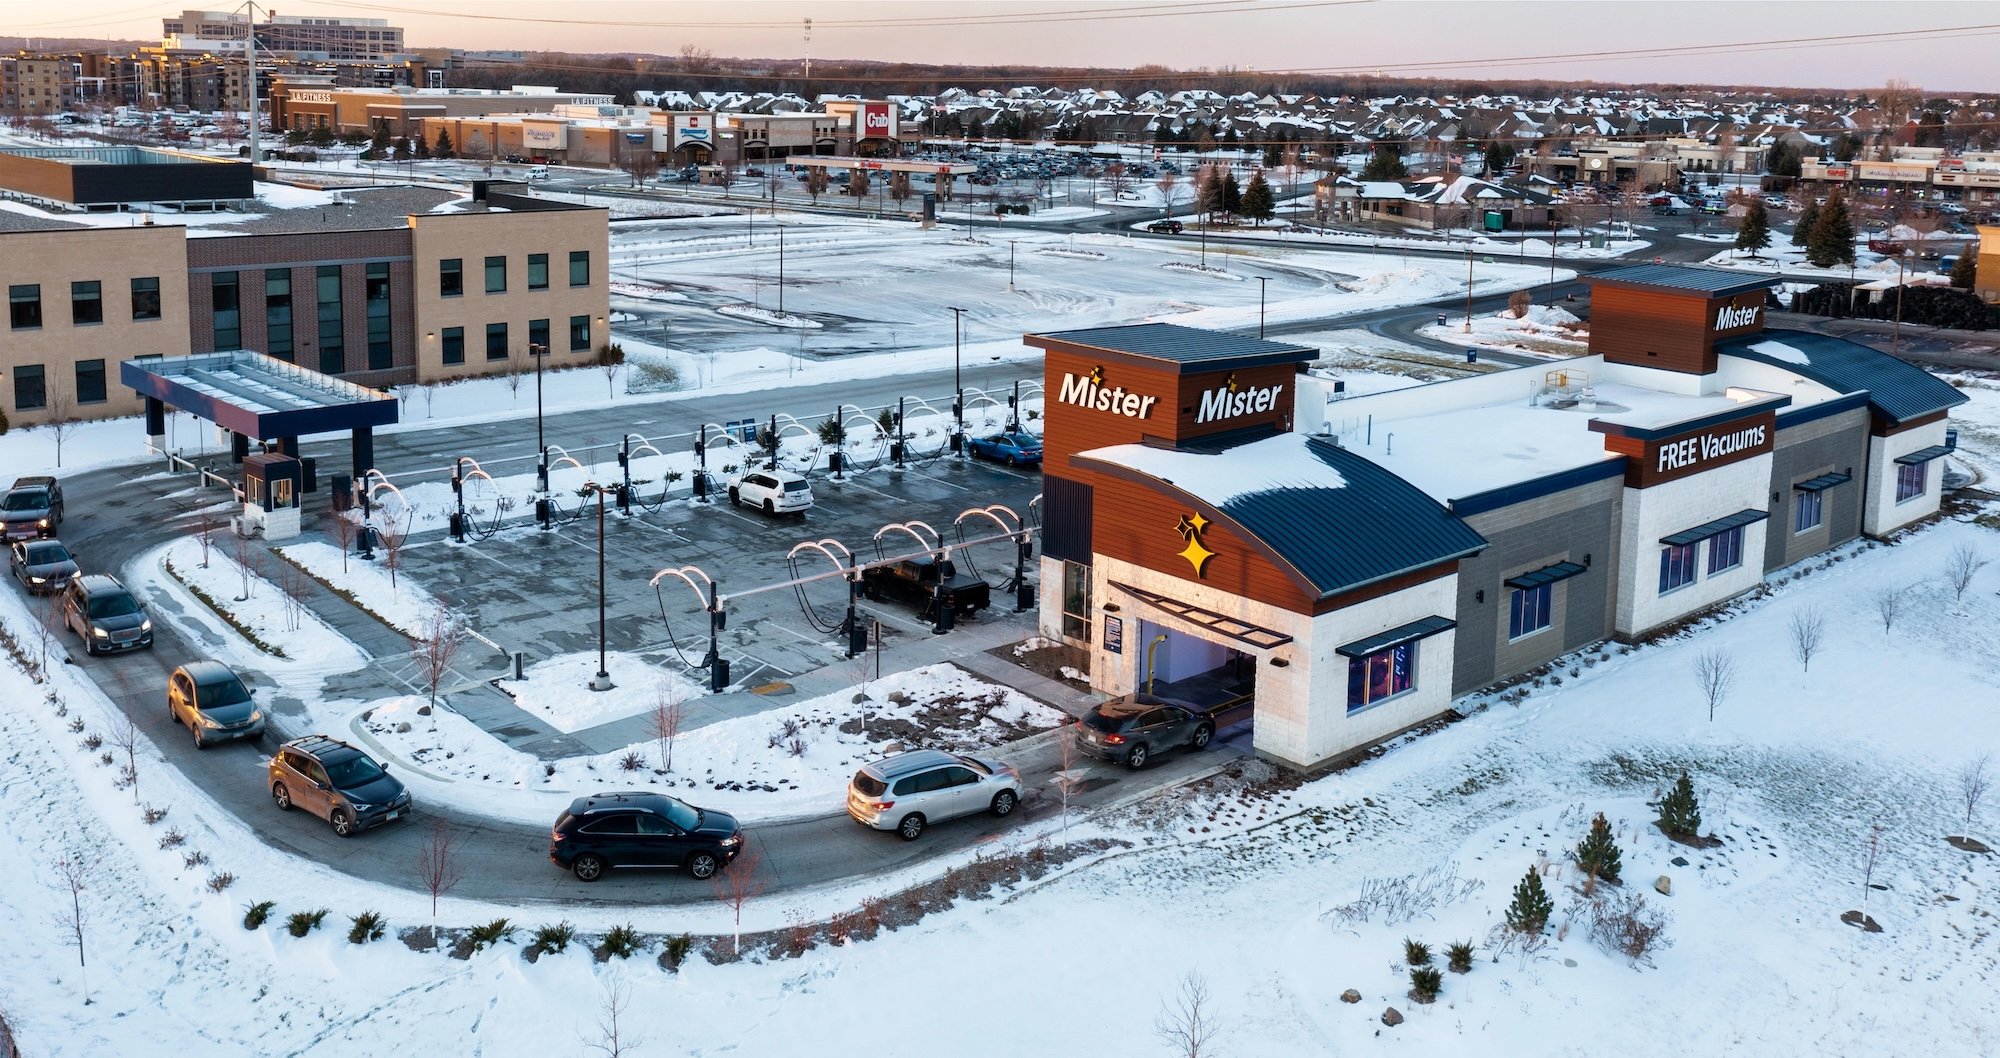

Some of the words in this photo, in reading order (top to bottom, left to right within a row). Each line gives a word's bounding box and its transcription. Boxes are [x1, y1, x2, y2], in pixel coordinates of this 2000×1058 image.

[292, 92, 301, 101] LA
[302, 93, 332, 102] FITNESS
[867, 112, 889, 128] Cub
[1716, 298, 1760, 331] Mister
[1058, 368, 1155, 420] Mister
[1196, 374, 1283, 424] Mister
[1657, 437, 1698, 473] FREE
[1700, 424, 1766, 460] Vacuums
